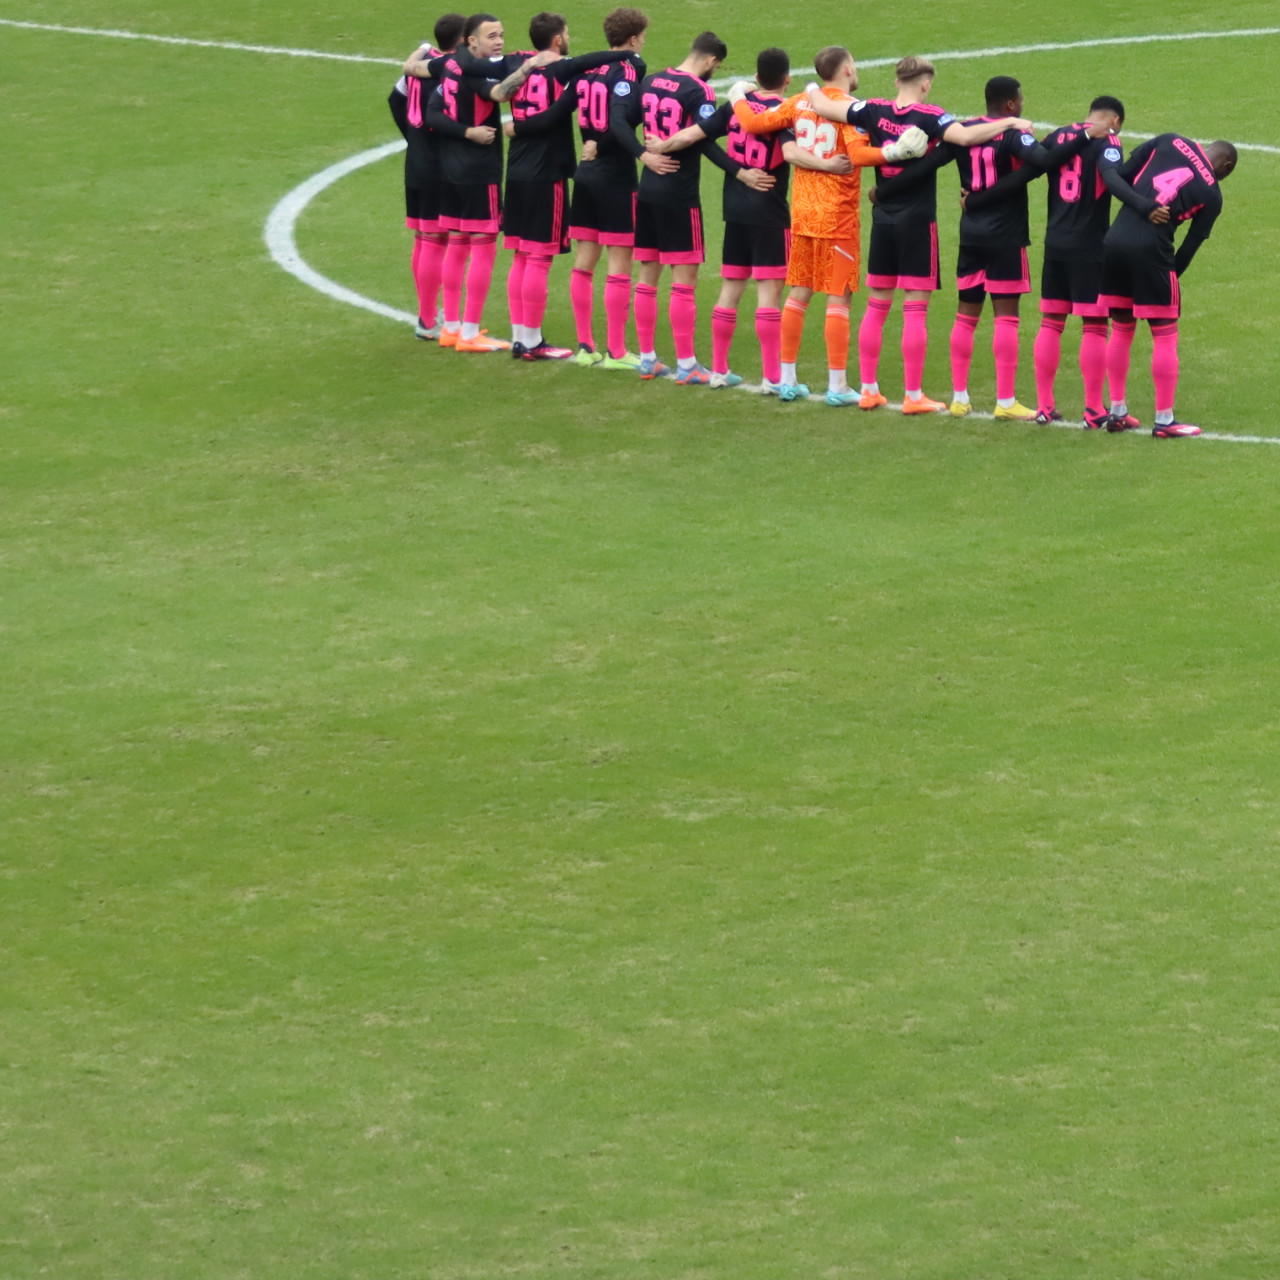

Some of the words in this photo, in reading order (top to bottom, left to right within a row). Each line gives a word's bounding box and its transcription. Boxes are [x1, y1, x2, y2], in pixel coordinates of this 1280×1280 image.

[576, 79, 609, 133] 20
[641, 92, 683, 141] 33
[727, 114, 768, 170] 26
[795, 118, 838, 160] 22
[970, 145, 998, 192] 11
[1153, 167, 1194, 206] 4
